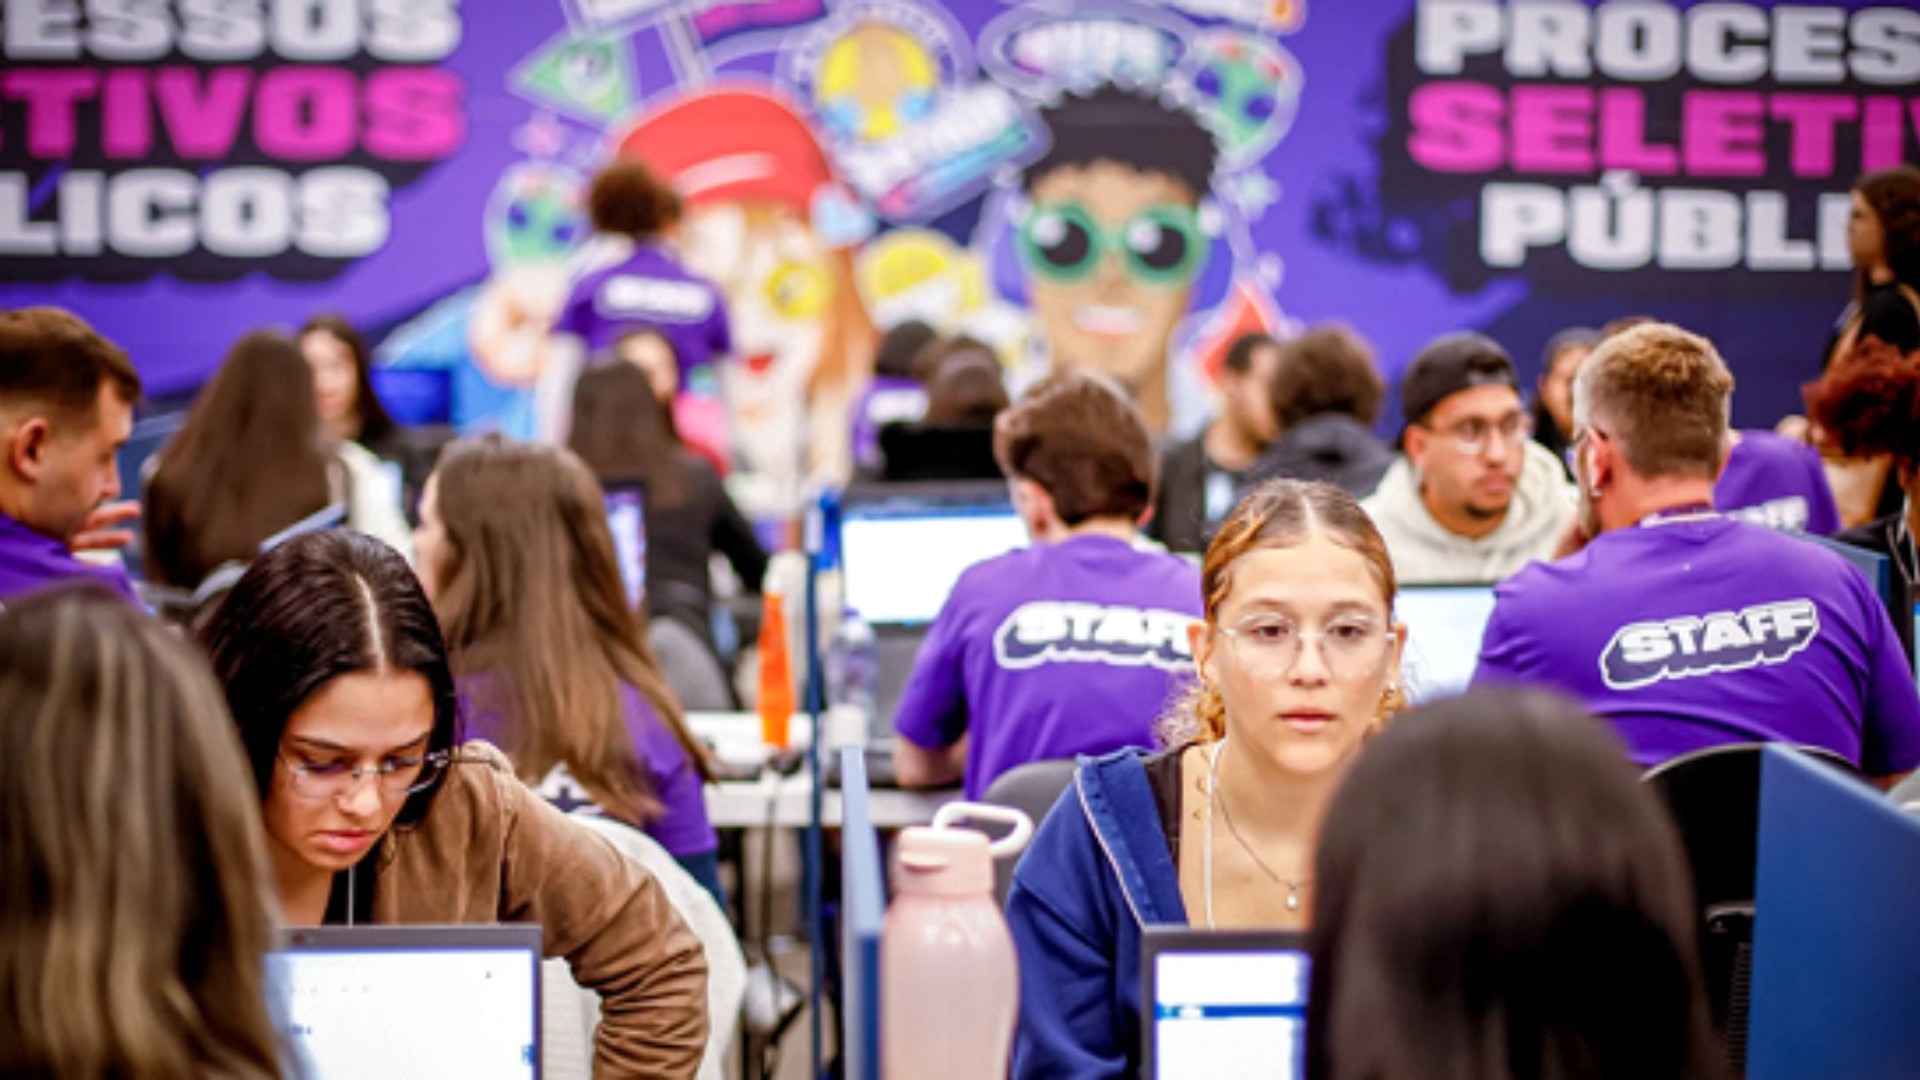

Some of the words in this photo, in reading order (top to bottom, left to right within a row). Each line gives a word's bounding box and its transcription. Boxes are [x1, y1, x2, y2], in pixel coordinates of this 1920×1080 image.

[3, 0, 462, 61] ESSOS
[1415, 0, 1920, 83] PROCES
[2, 67, 465, 160] TIVOS
[1407, 80, 1920, 177] SELETI
[0, 167, 391, 257] LICOS
[1479, 169, 1853, 271] PÚBLI
[1611, 599, 1816, 673] STAFF
